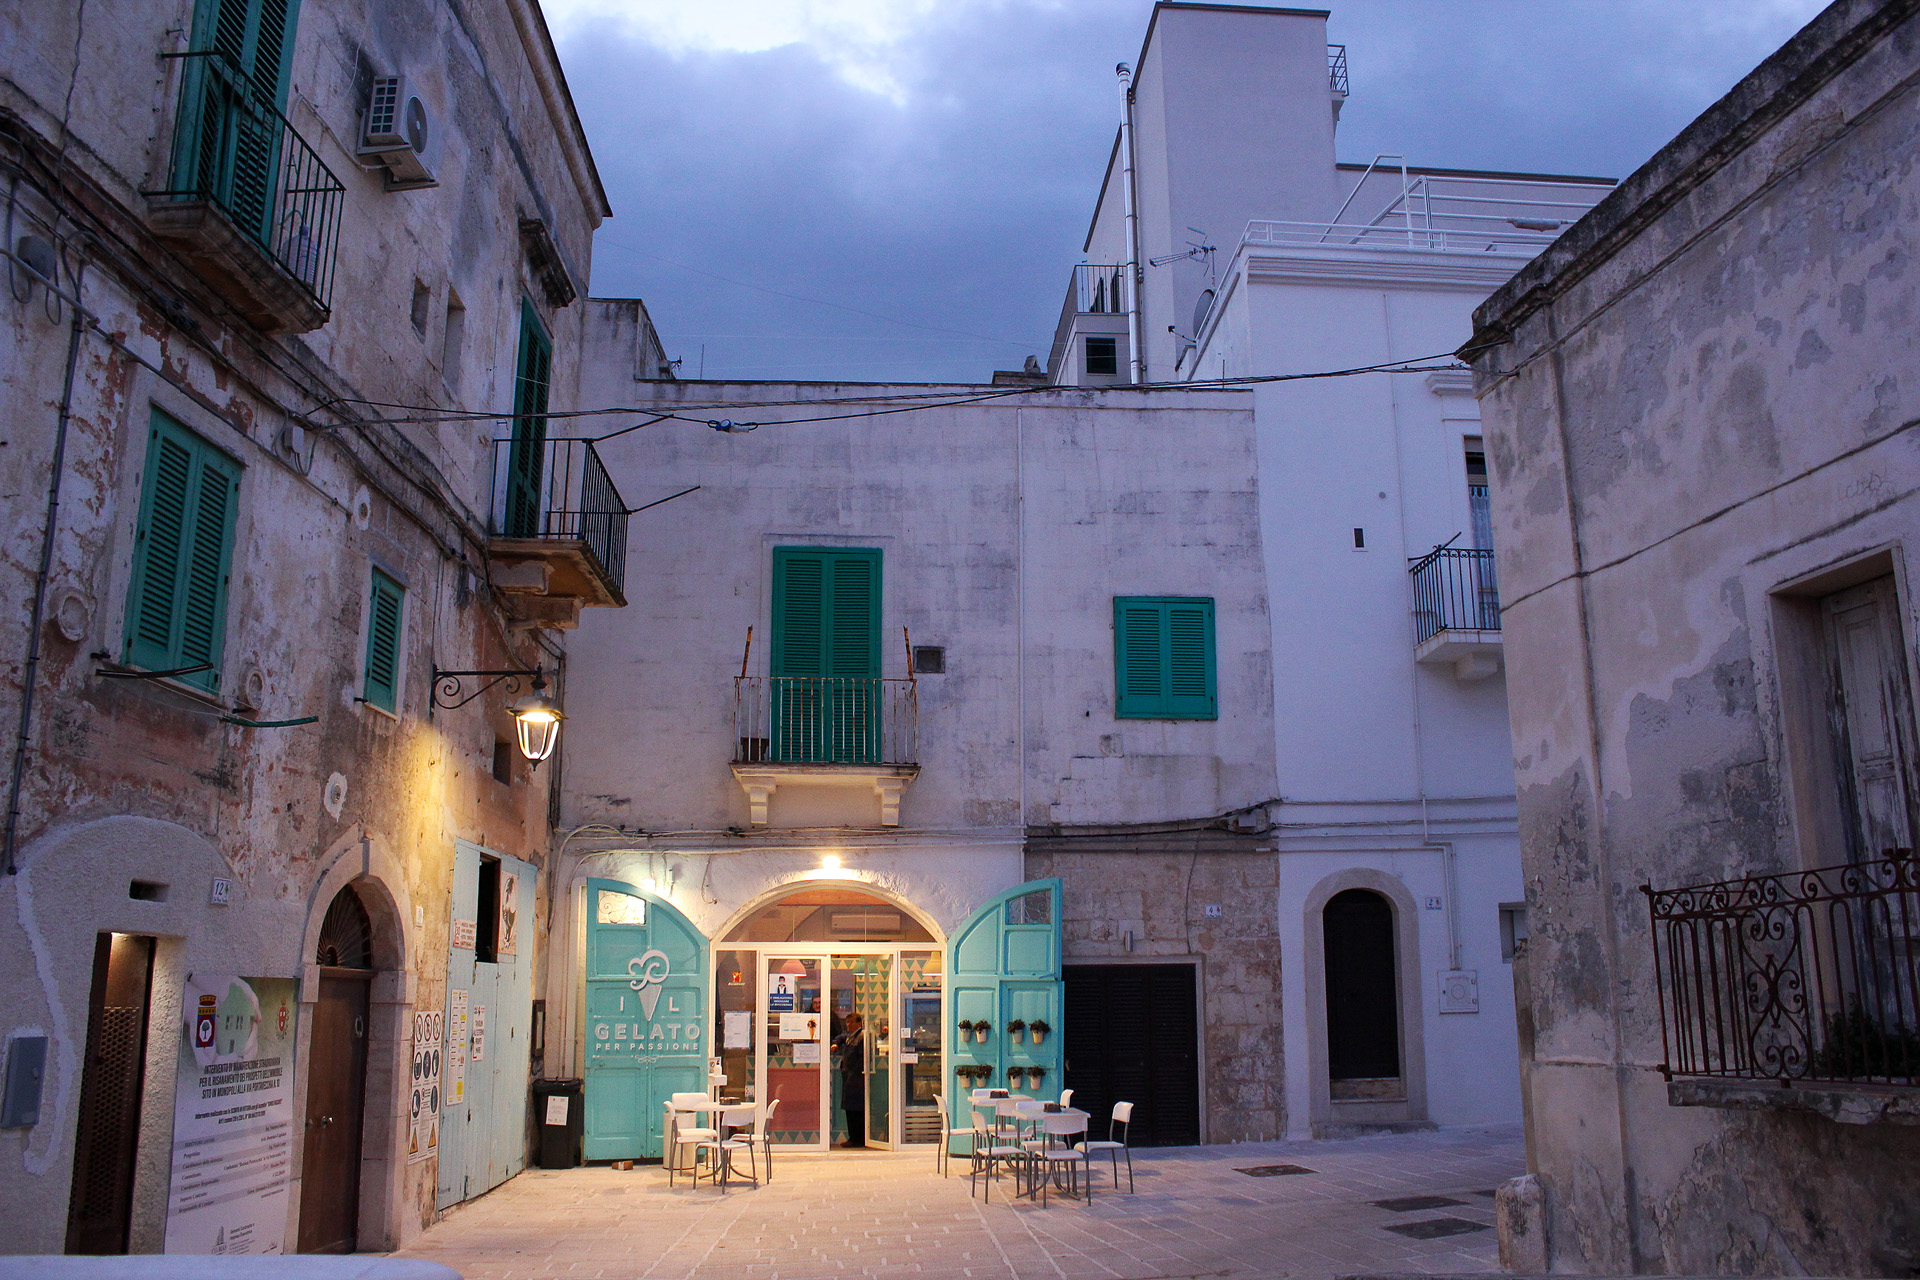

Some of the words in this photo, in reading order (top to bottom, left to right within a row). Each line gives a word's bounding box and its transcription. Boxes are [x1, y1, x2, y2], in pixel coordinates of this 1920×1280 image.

[215, 882, 224, 896] 12
[594, 1023, 701, 1040] GELATO
[595, 1043, 620, 1051] PER
[630, 1043, 698, 1051] PASSIONE
[199, 1077, 207, 1087] PER
[202, 1088, 211, 1099] SITO
[218, 1084, 236, 1097] MONOPOLI
